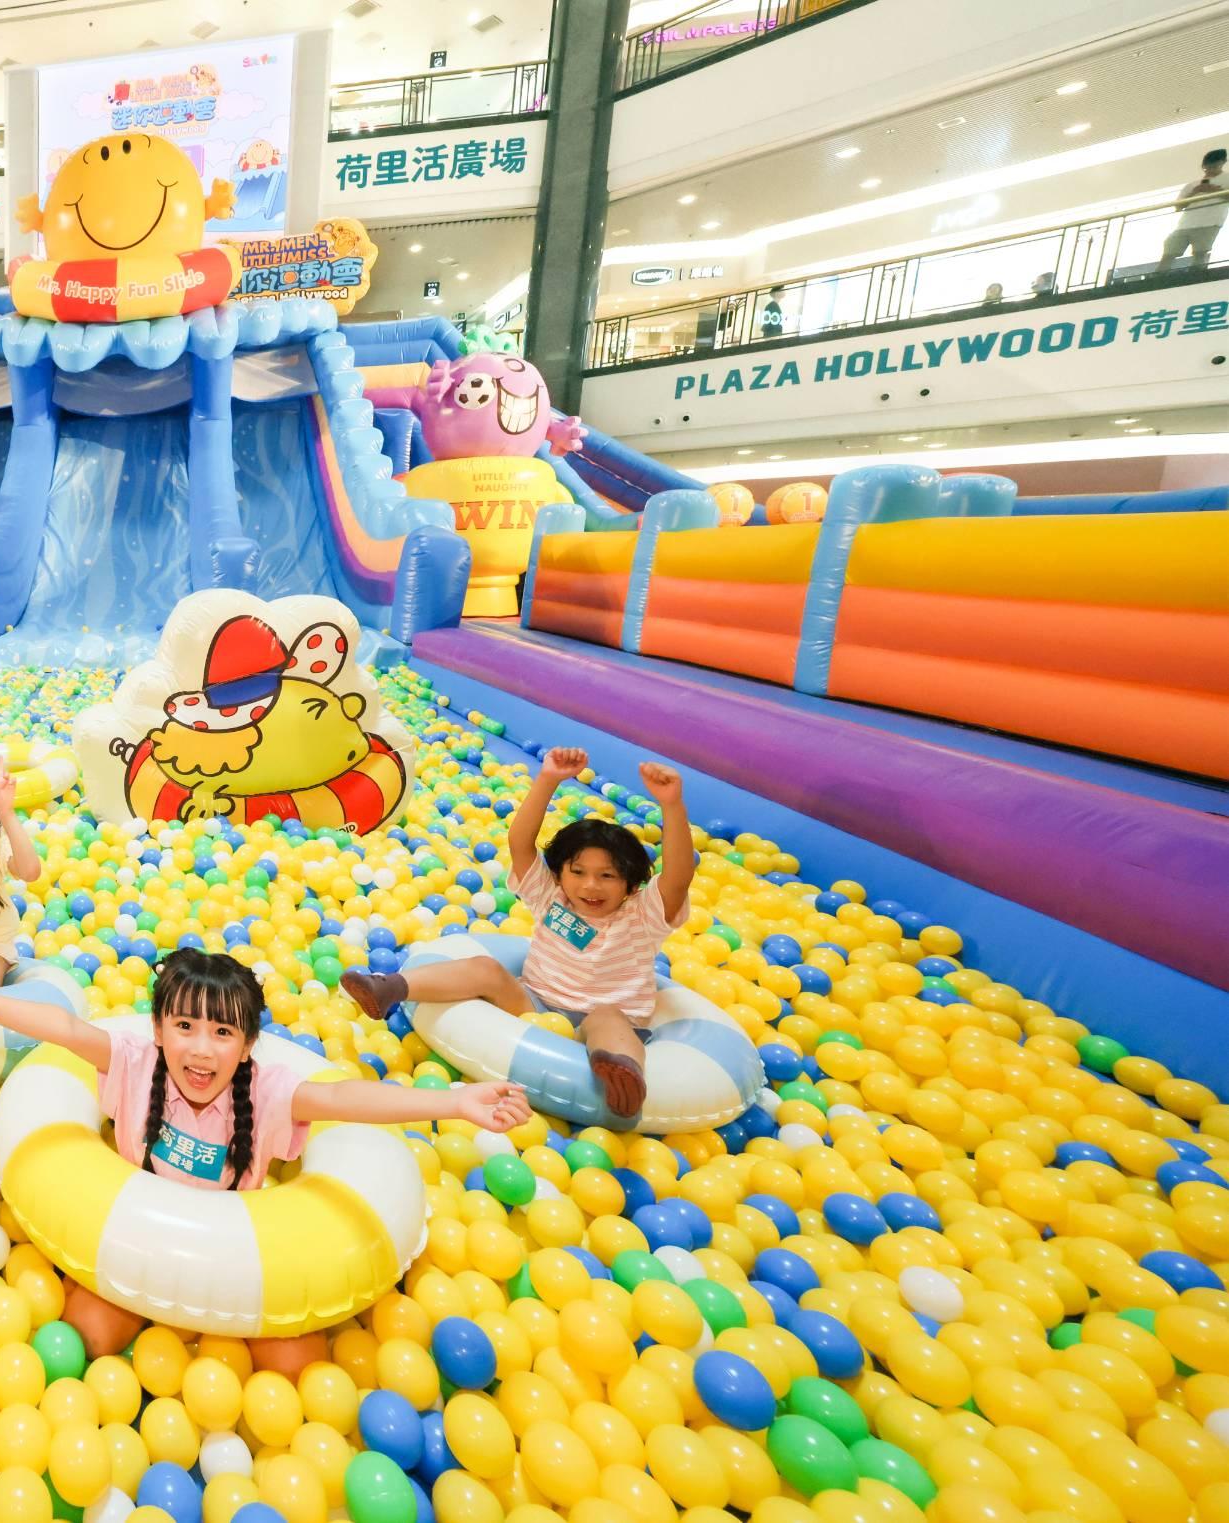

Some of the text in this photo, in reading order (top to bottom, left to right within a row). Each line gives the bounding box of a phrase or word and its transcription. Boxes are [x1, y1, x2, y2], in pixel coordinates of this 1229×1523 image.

[336, 137, 528, 191] 荷里活廣場
[37, 269, 206, 305] Mr. Happy Fun Slide
[240, 257, 364, 293] 你運動會
[674, 360, 800, 400] PLAZA
[813, 315, 1118, 382] HOLLYWOOD
